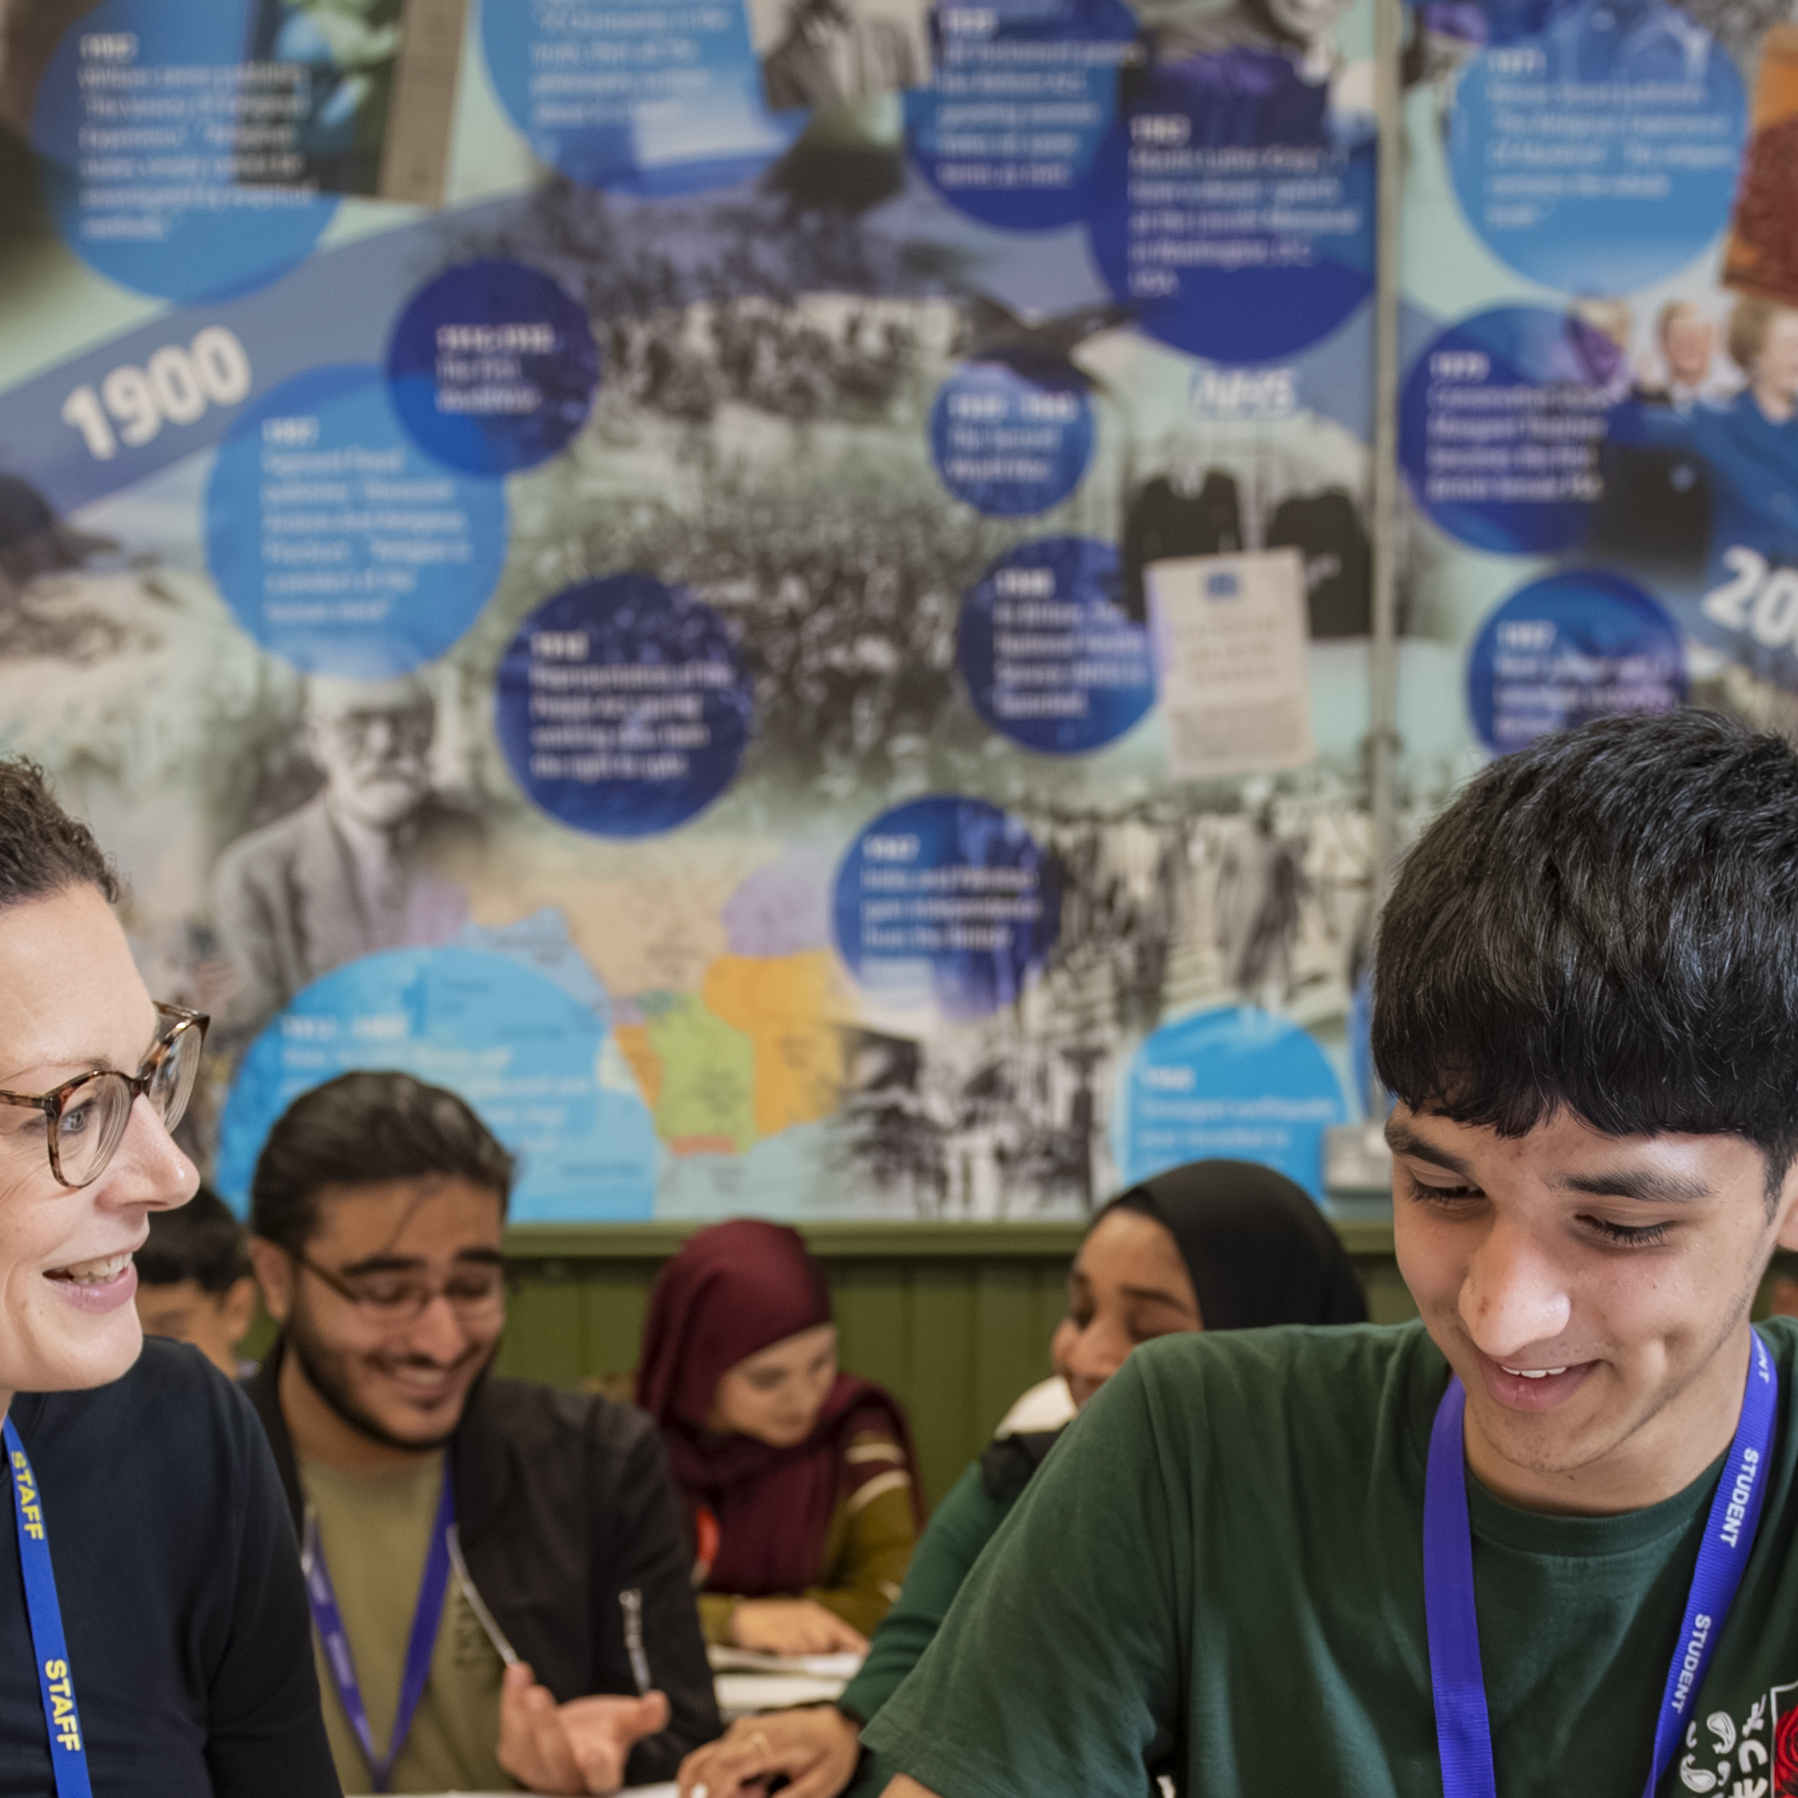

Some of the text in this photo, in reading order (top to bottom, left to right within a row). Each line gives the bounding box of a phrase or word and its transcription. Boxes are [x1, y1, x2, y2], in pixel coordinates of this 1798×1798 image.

[61, 325, 254, 462] 1900
[9, 1449, 46, 1541] STAFF
[1719, 1446, 1761, 1549] STUDENT
[44, 1657, 83, 1753] STAFF
[1670, 1612, 1712, 1714] STUDENT
